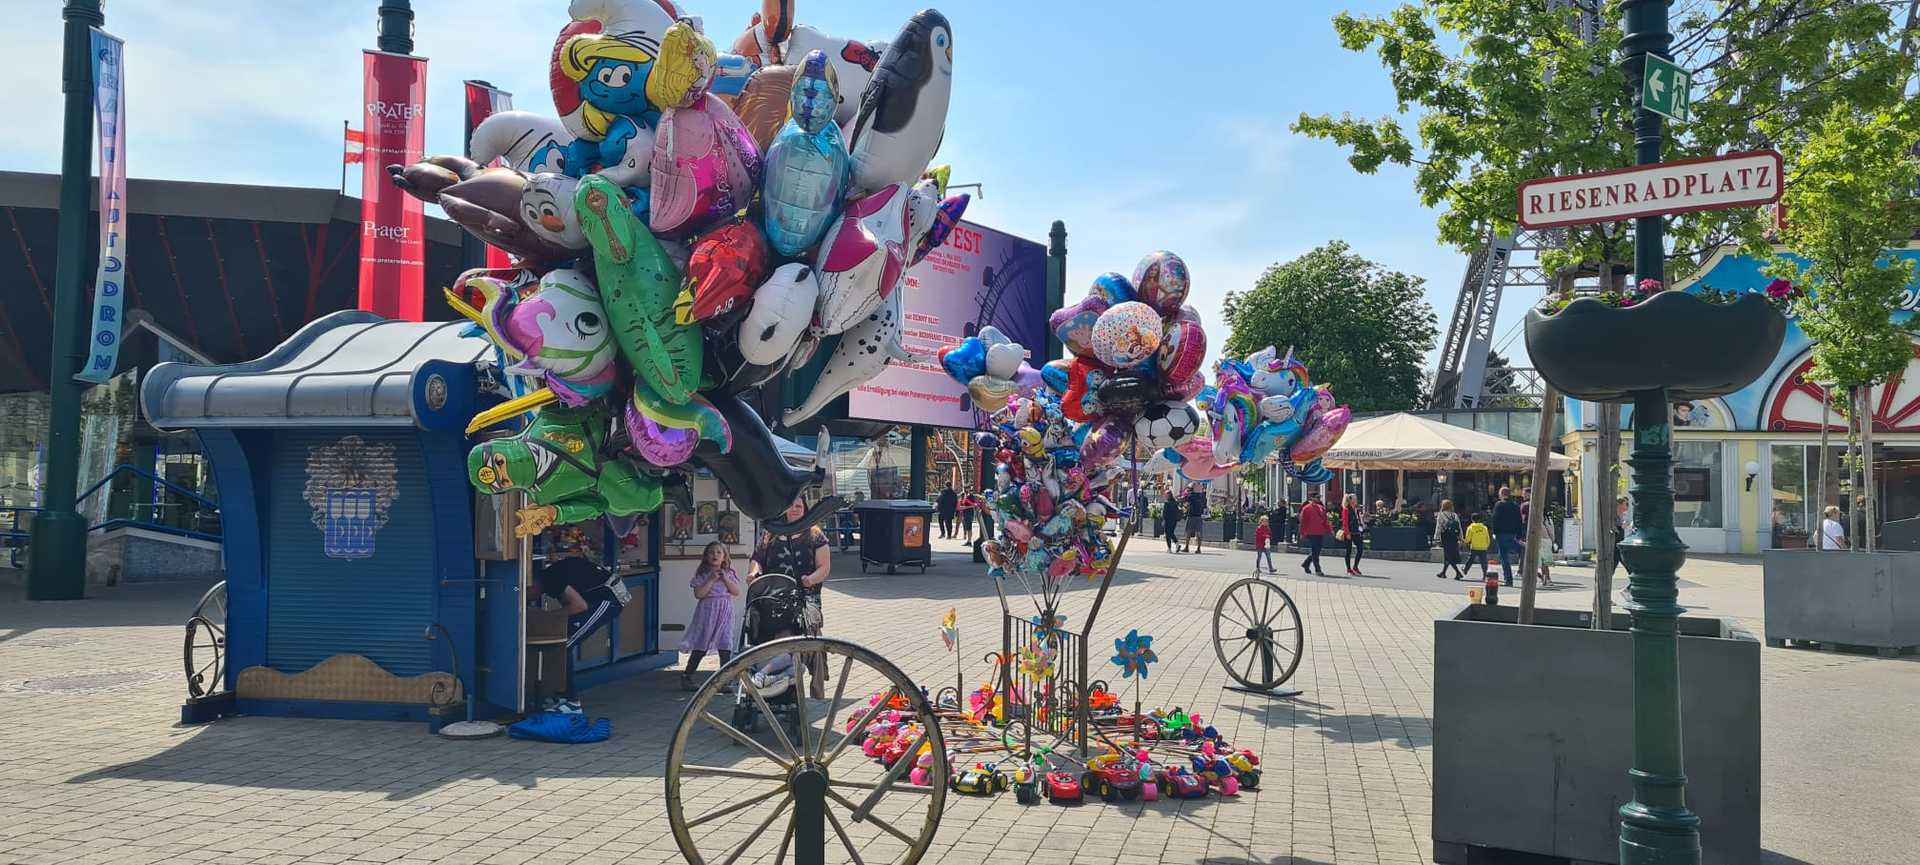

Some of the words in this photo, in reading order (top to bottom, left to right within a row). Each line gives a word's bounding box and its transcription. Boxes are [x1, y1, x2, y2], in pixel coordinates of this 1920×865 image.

[367, 100, 424, 120] PRATER
[1529, 165, 1772, 216] RIESENRADPLATZ
[360, 220, 411, 240] Prater
[943, 226, 983, 257] EST
